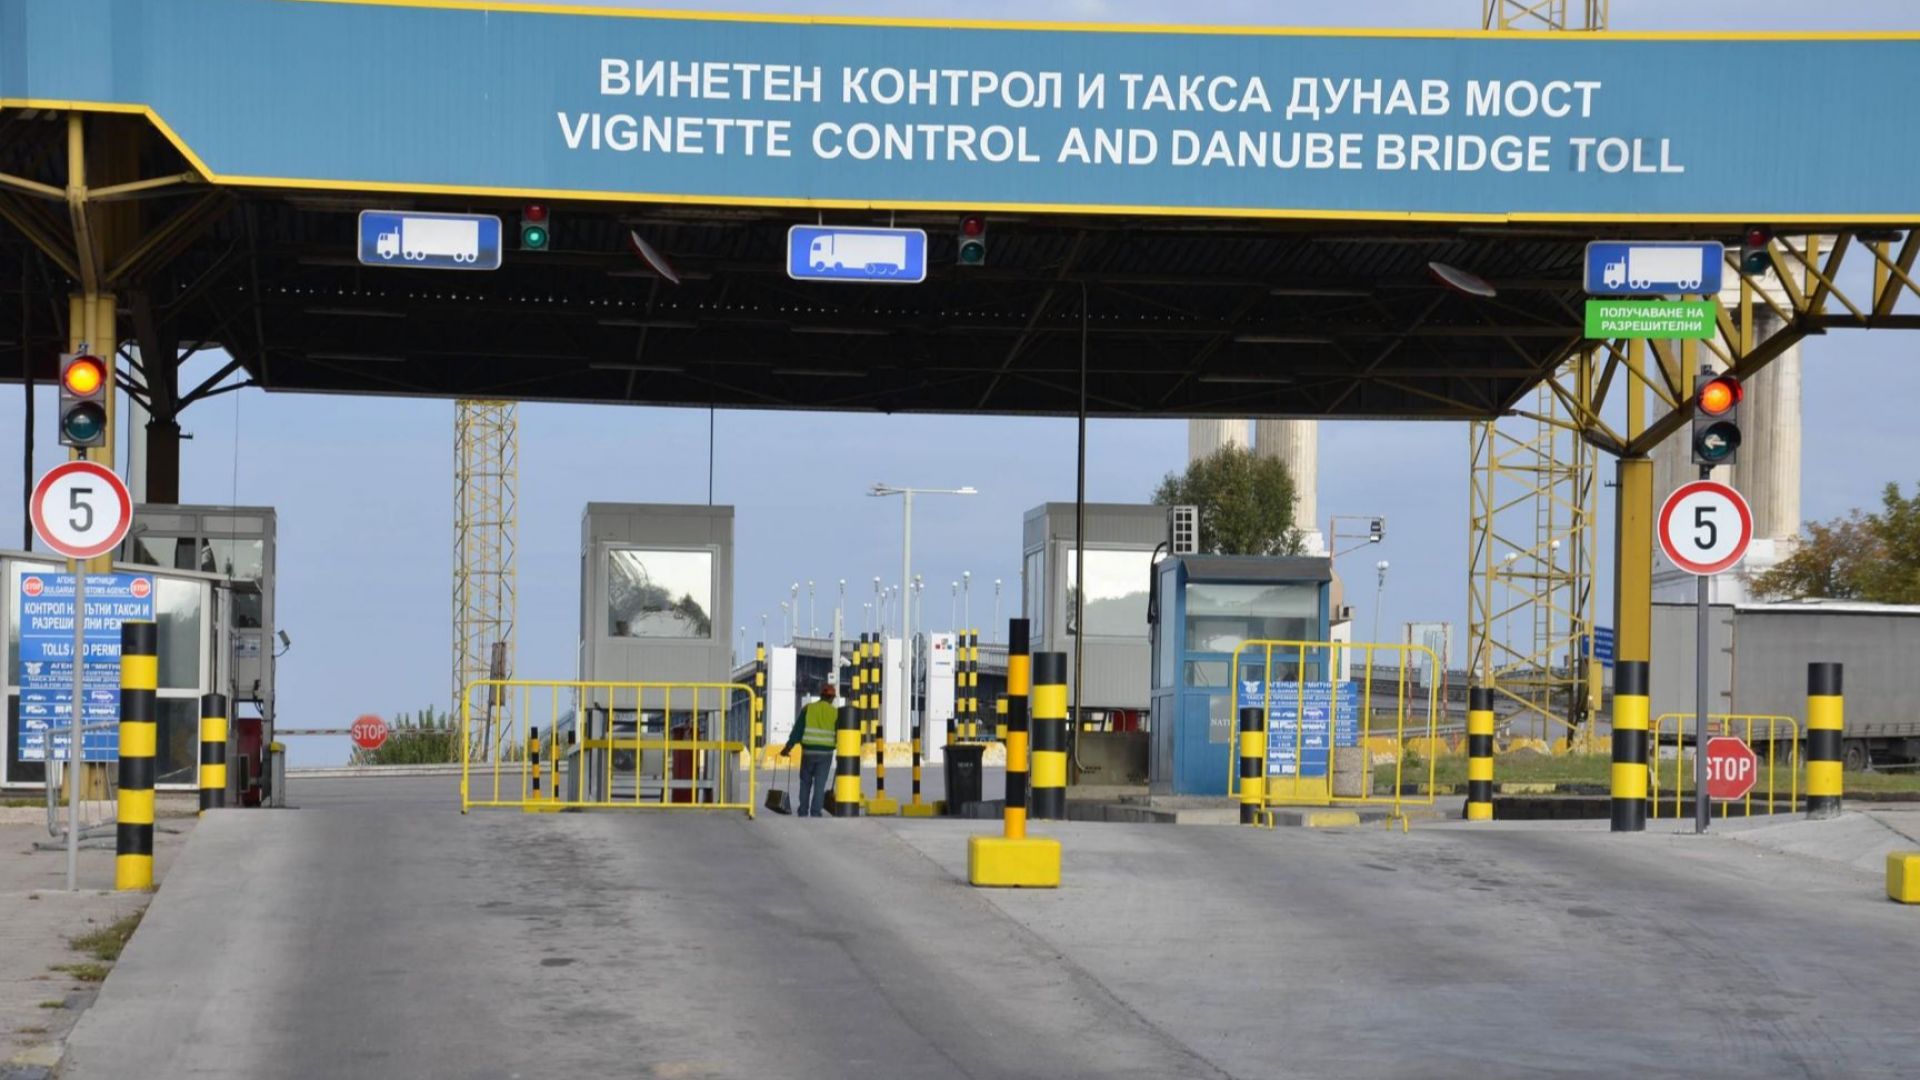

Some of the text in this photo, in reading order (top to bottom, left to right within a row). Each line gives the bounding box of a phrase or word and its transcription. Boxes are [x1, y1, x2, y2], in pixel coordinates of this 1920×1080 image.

[601, 58, 1601, 120] ВИНЕТЕН КОНТРОЛ И ТАКСА ДУНАВ МОСТ
[557, 111, 1685, 173] VIGNETTE CONTROL AND DANUBE BRIDGE TOLL
[1600, 307, 1704, 318] ПОЛУЧАВАНЕ НА
[1601, 320, 1702, 331] РАЗРЕШИТЕЛНИ
[69, 487, 93, 532] 5
[1694, 506, 1717, 550] 5
[24, 602, 65, 615] КОНТРОЛ
[113, 603, 141, 616] ТАКСИ
[142, 604, 149, 616] И
[41, 643, 70, 656] TOLLS
[353, 724, 386, 740] STOP
